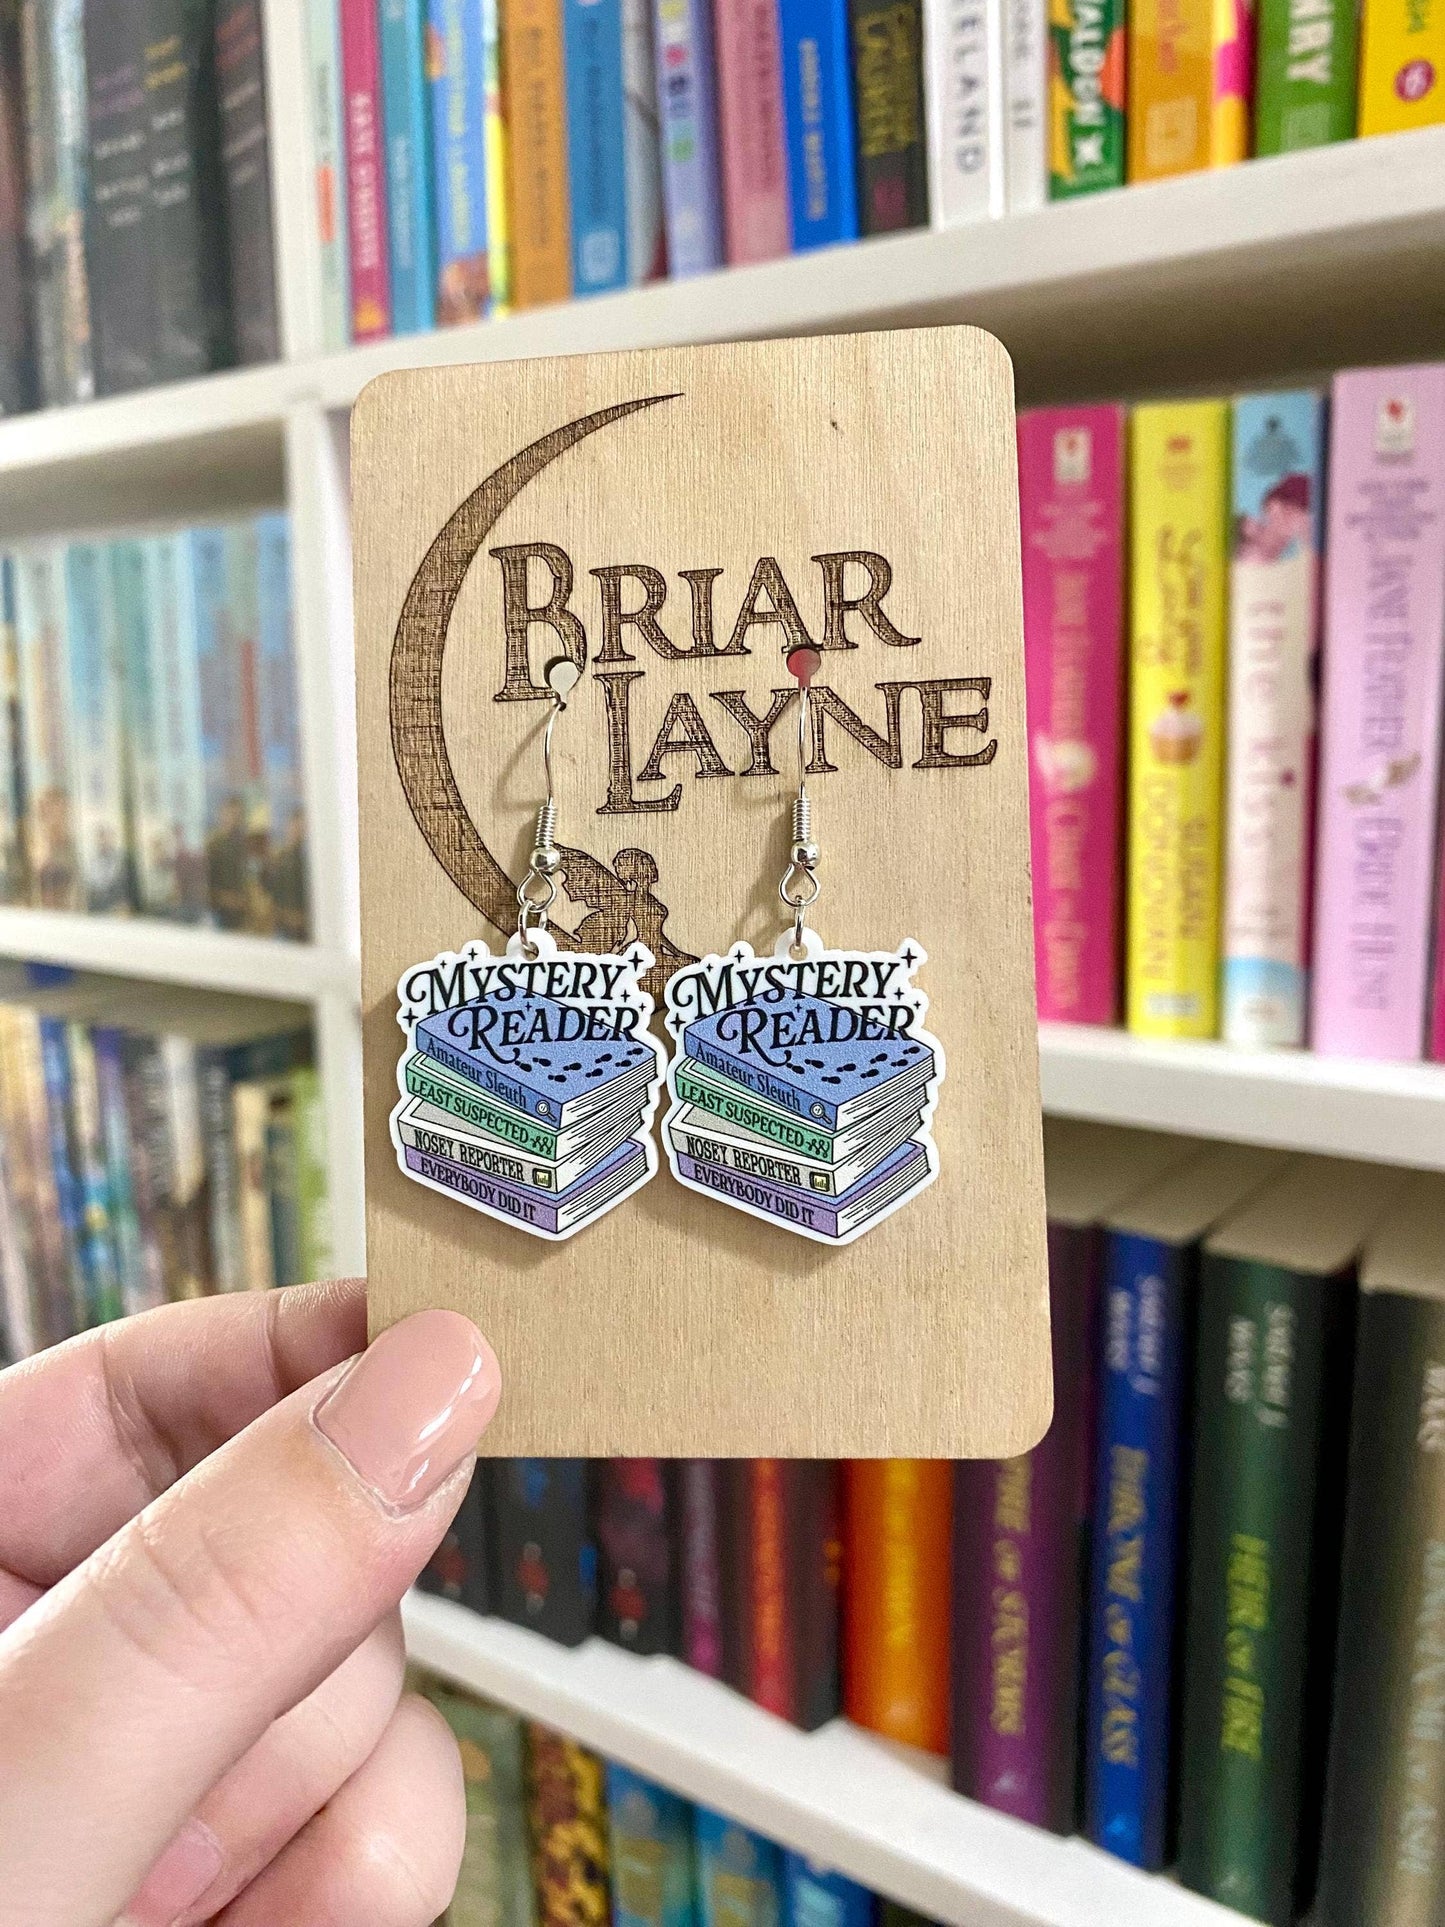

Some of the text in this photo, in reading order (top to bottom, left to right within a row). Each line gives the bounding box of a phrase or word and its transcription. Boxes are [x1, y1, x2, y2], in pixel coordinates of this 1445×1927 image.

[489, 542, 922, 701] BRIAR
[593, 670, 998, 814] LAYNE
[406, 962, 627, 1014] MYSTERY
[672, 960, 900, 1019] MYSTERY
[447, 1005, 640, 1064] READER
[716, 1004, 915, 1067] READER
[427, 1037, 527, 1109] Amateur Sleuth
[696, 1046, 802, 1110] Amateur Sleuth
[411, 1076, 529, 1144] LEAST SUSPECTED
[681, 1081, 804, 1149] LEAST SUSPECTED
[420, 1157, 537, 1221] EVERYBODY DID IT
[460, 1145, 525, 1182] REPORTER
[694, 1163, 815, 1225] EVERYBODY DID IT
[733, 1149, 802, 1186] REPORTER
